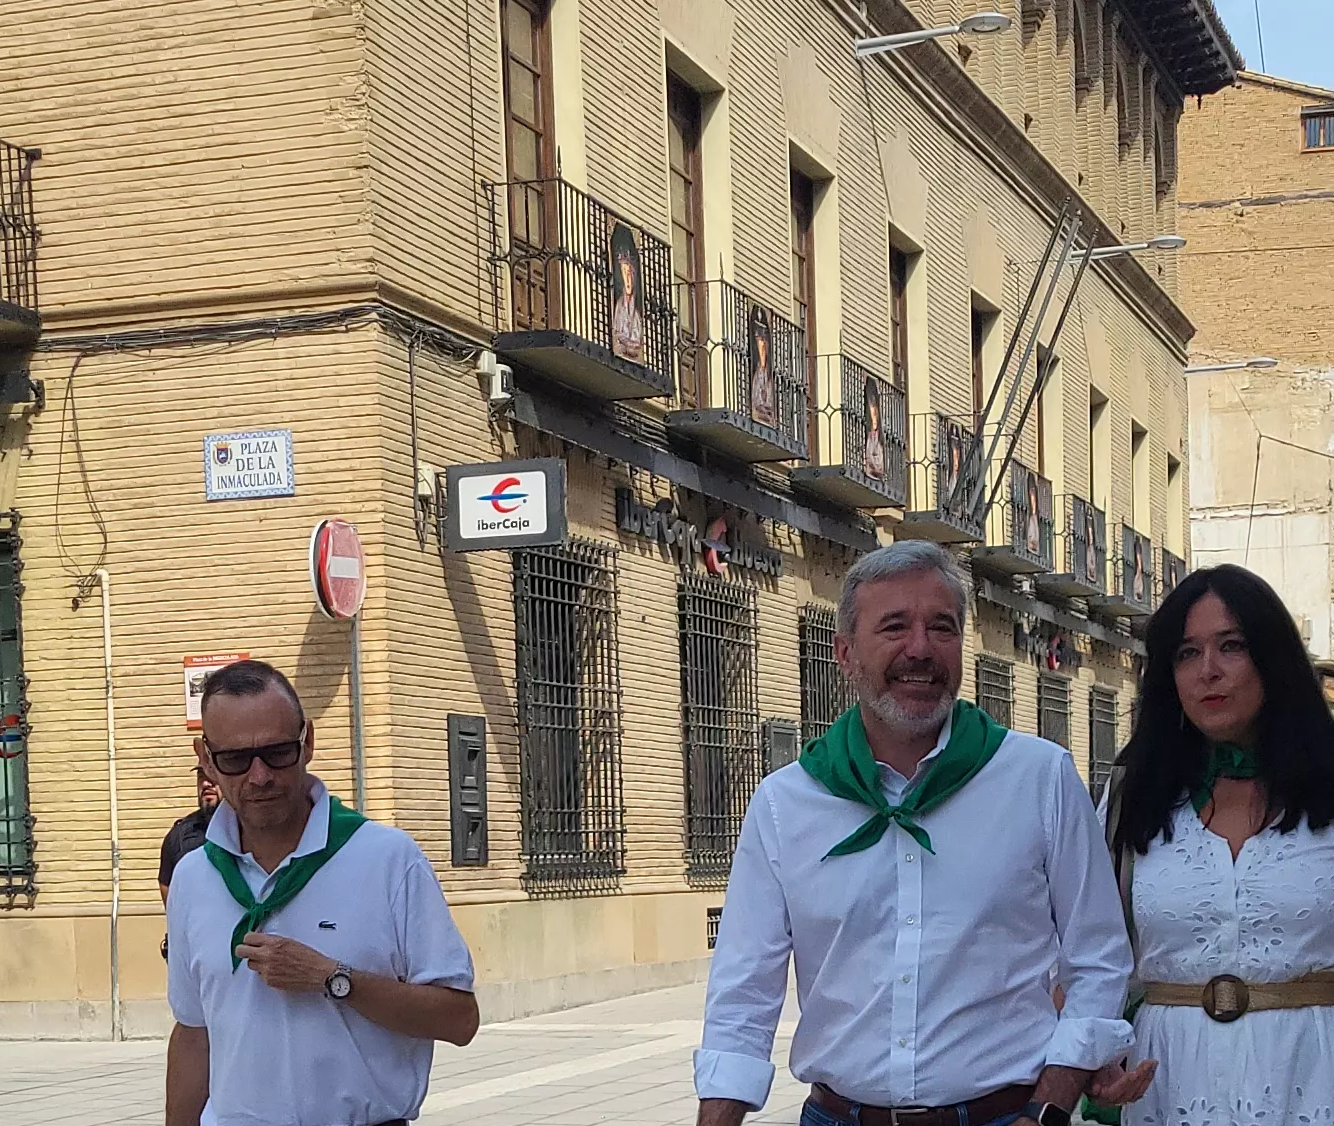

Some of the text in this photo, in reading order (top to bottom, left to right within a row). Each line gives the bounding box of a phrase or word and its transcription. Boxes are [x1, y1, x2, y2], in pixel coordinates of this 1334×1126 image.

[240, 440, 278, 455] PLAZA
[235, 455, 276, 472] DE LA
[216, 471, 283, 490] INMACULADA
[477, 516, 530, 531] iberCaja
